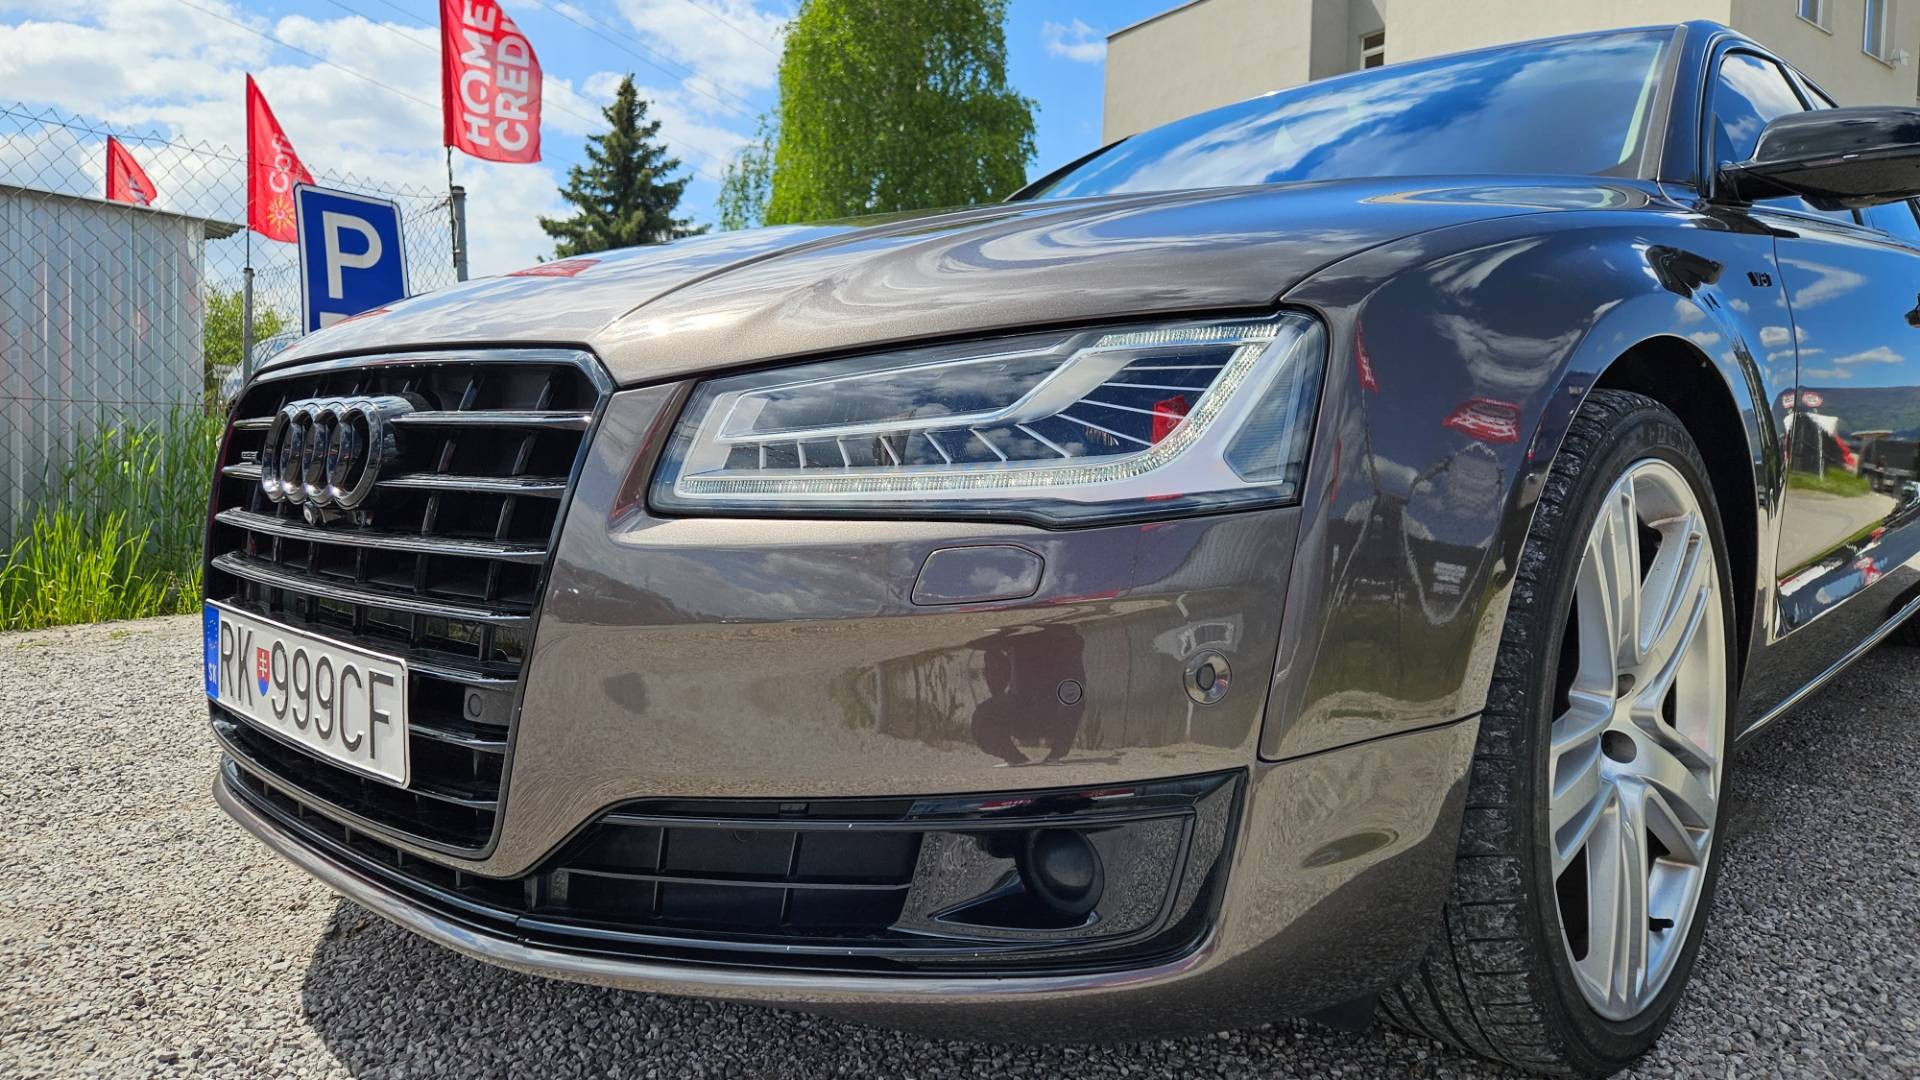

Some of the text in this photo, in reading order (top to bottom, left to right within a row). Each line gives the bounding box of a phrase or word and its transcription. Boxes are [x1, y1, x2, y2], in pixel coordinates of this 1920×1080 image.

[460, 0, 497, 147] HOME
[322, 210, 383, 299] P
[208, 662, 217, 685] SK
